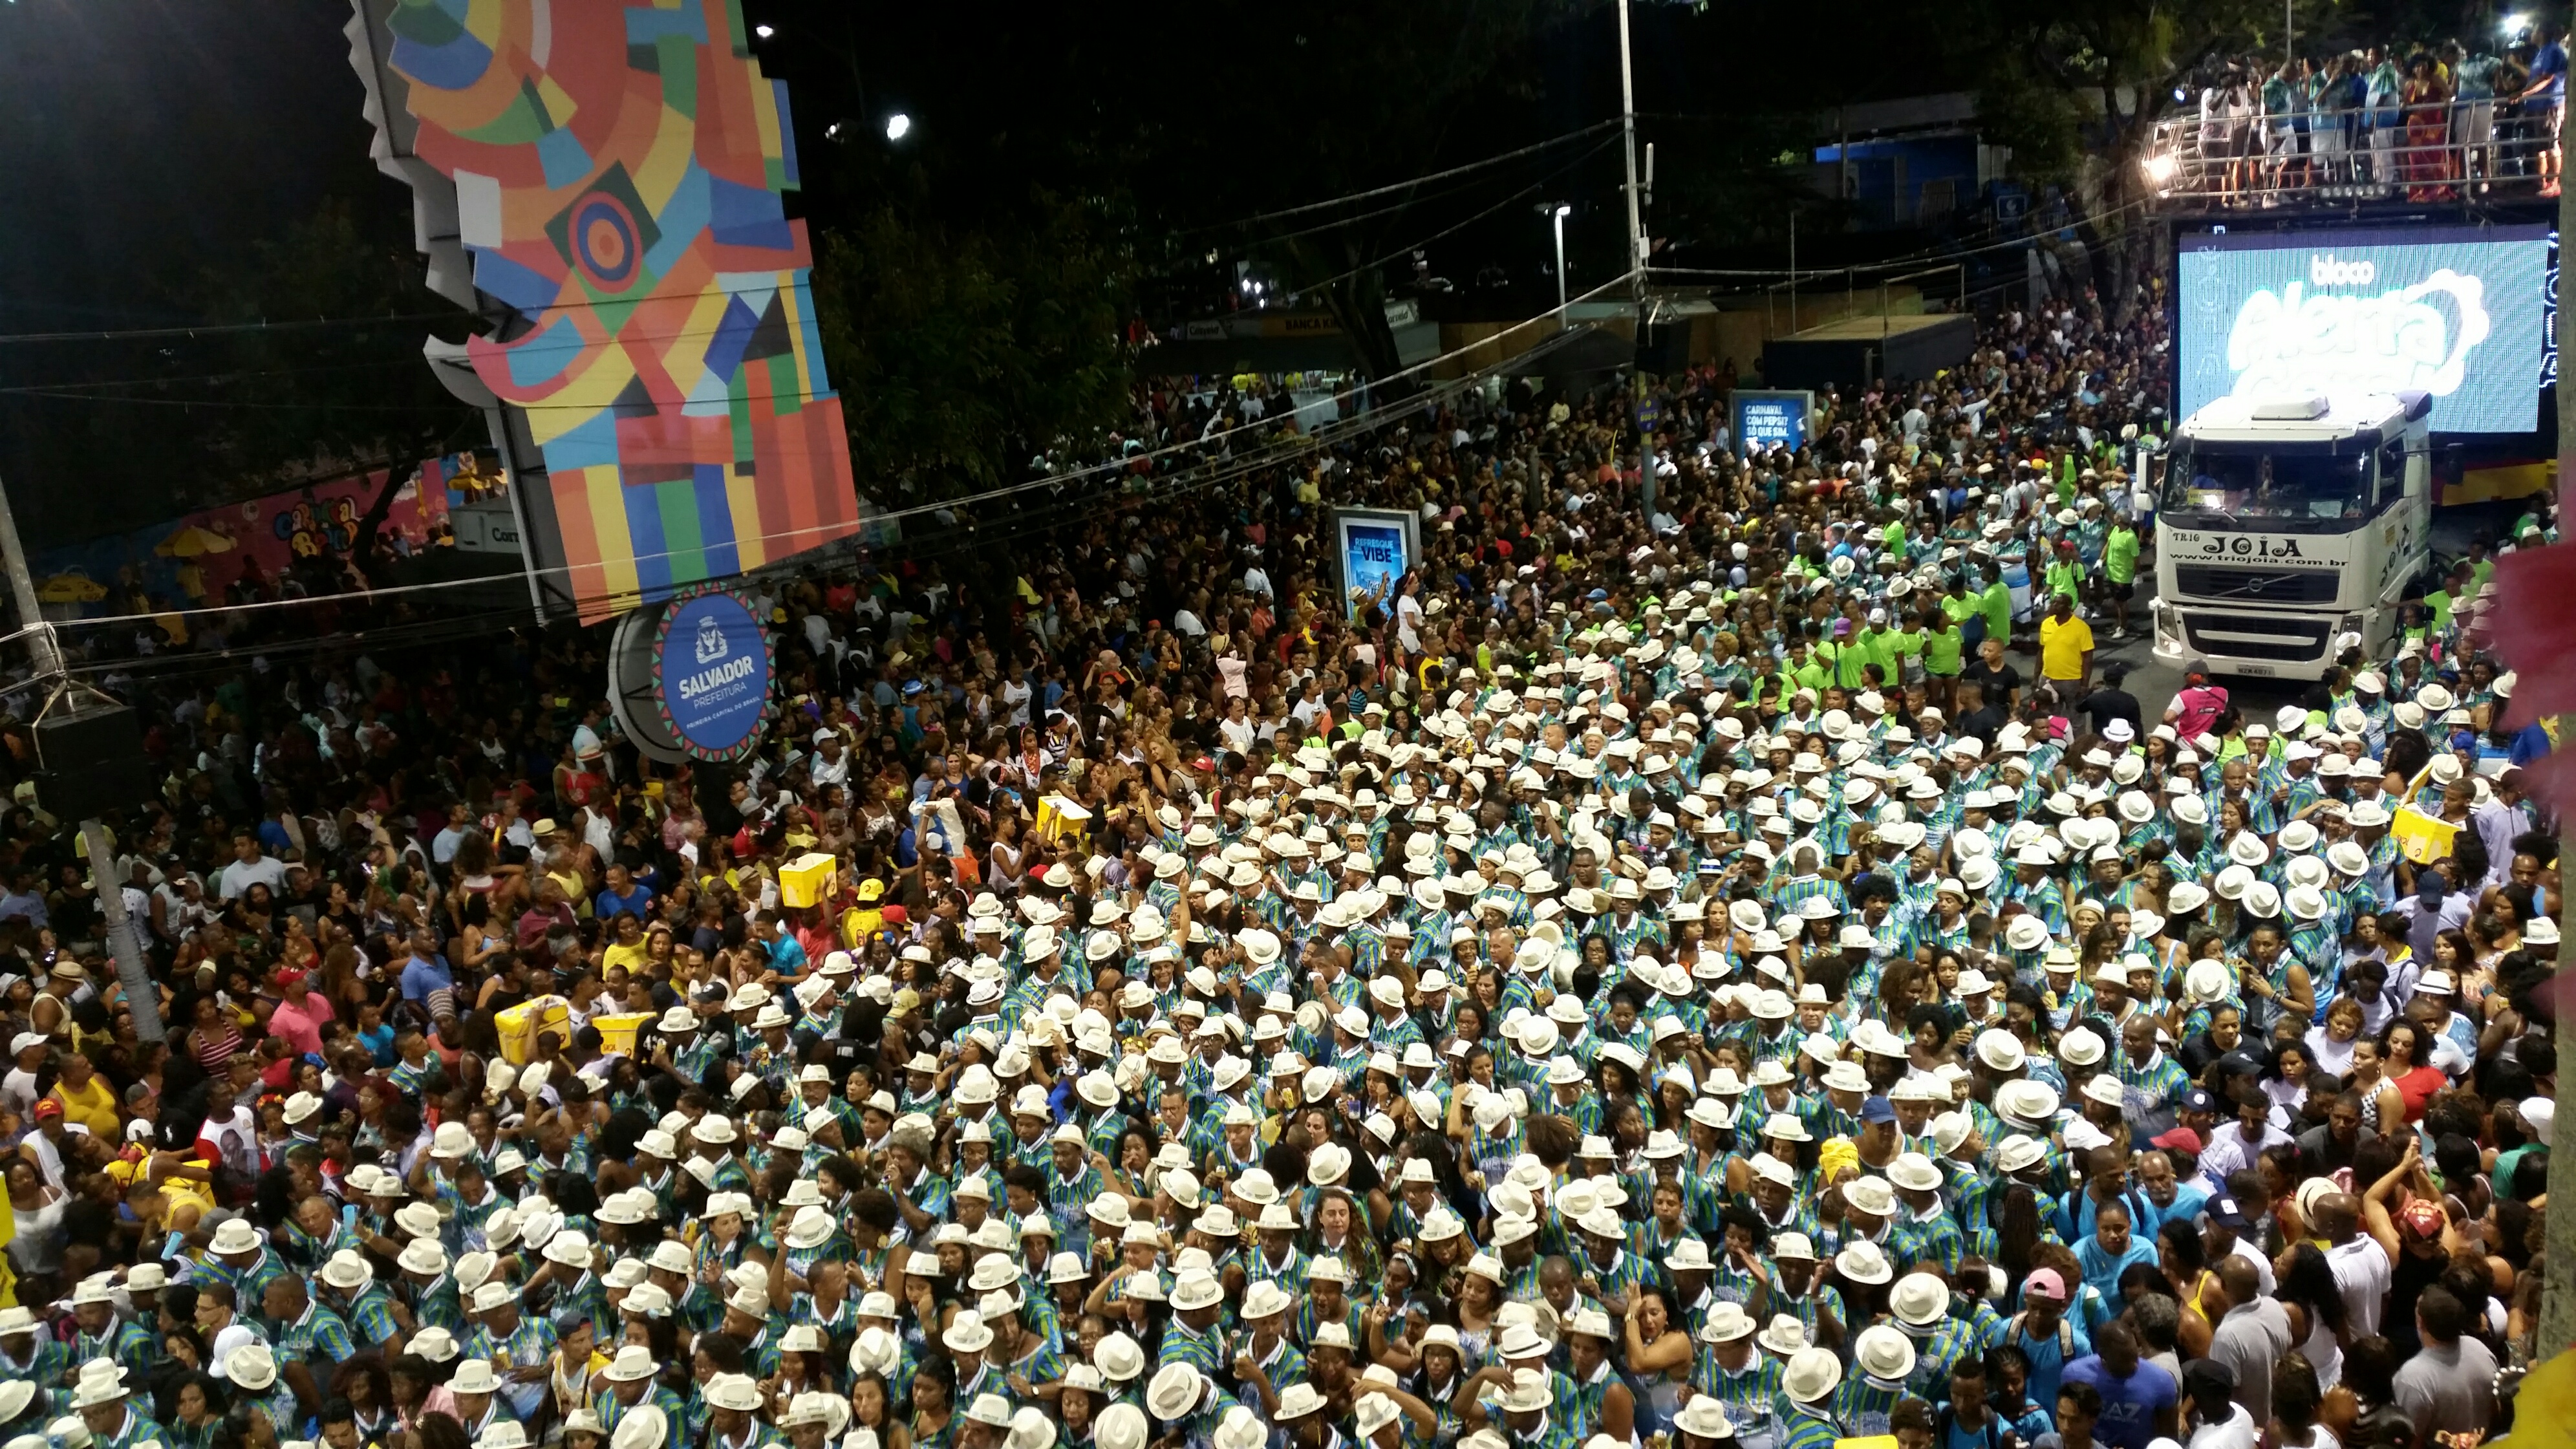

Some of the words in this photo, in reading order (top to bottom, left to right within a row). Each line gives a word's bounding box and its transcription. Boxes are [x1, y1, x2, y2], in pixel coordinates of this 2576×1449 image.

[2312, 254, 2374, 285] bloco
[1285, 318, 1320, 330] BANCA
[1746, 405, 1783, 414] CARNAVAL
[1746, 416, 1763, 425] COM
[1763, 416, 1788, 426] PEPSI?
[1746, 425, 1757, 435] SÓ
[1757, 427, 1772, 436] QUE
[1355, 538, 1393, 548] REFRESQUE
[1361, 546, 1392, 563] VIBE
[2170, 553, 2348, 566] www.triojoia.com.br
[679, 655, 755, 700] SALVADOR
[693, 682, 747, 709] PREFEITURA
[686, 716, 711, 729] PRIMEIRA
[712, 707, 733, 719] CAPITAL
[743, 696, 760, 707] BRASIL
